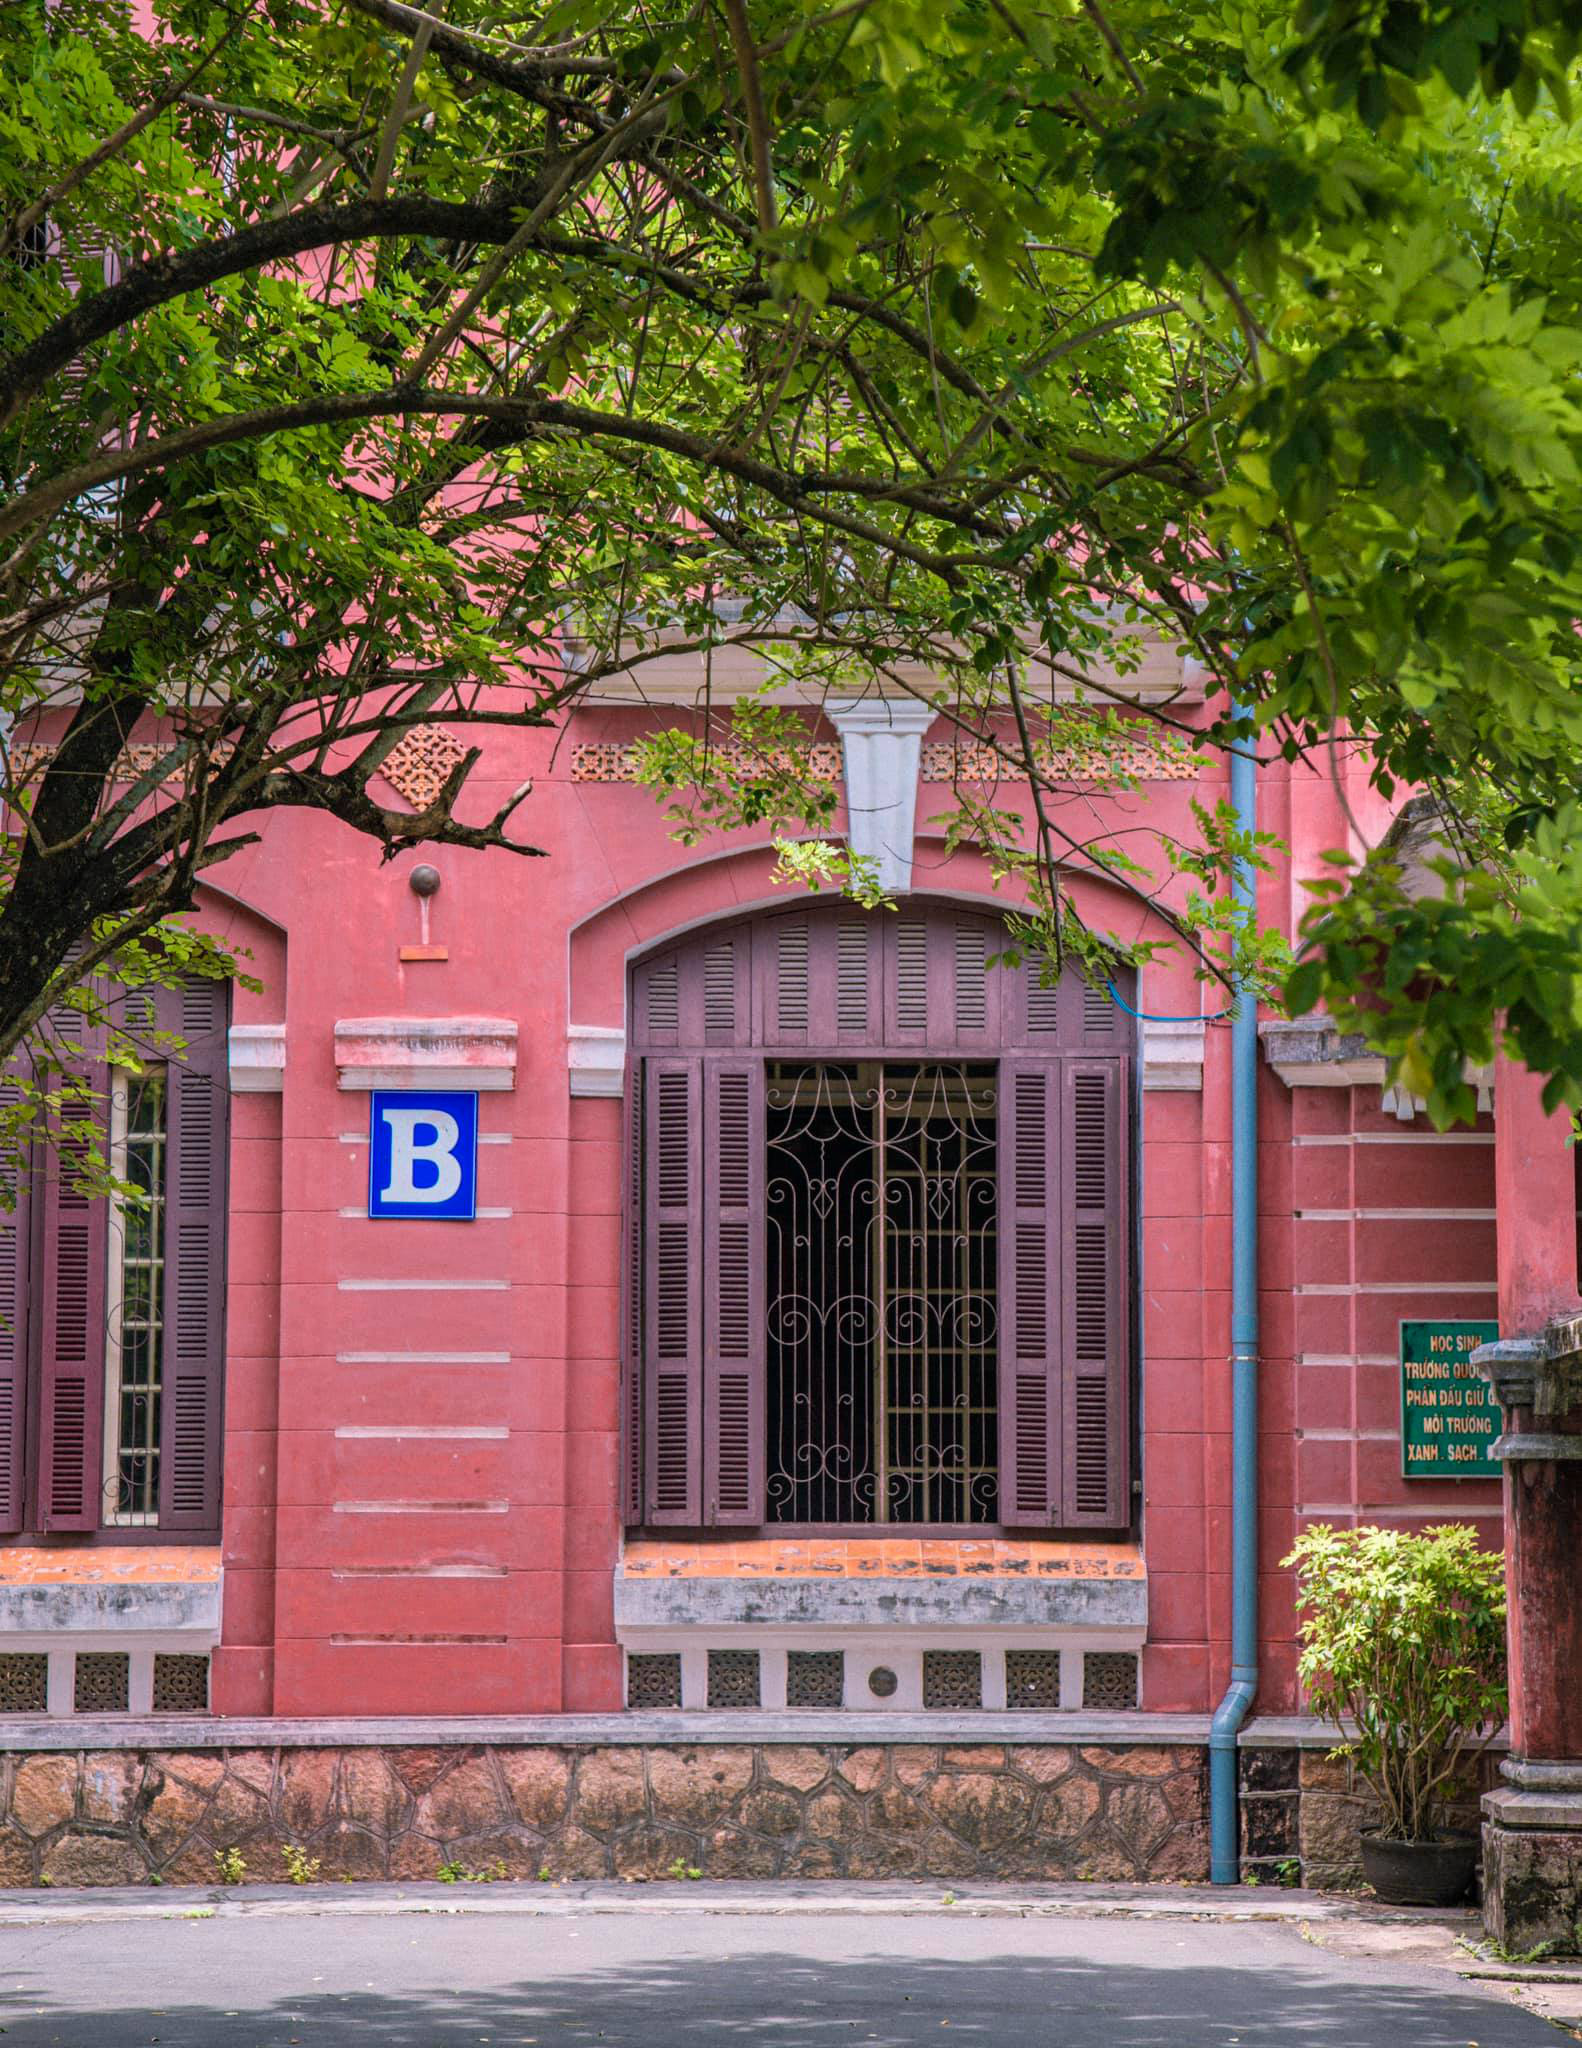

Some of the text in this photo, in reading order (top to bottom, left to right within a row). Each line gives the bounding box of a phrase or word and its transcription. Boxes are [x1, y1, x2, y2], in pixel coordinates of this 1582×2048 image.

[380, 1108, 462, 1203] B
[1430, 1335, 1482, 1354] HỌC SINH
[1407, 1444, 1438, 1461] XANH
[1447, 1444, 1477, 1463] SẠCH
